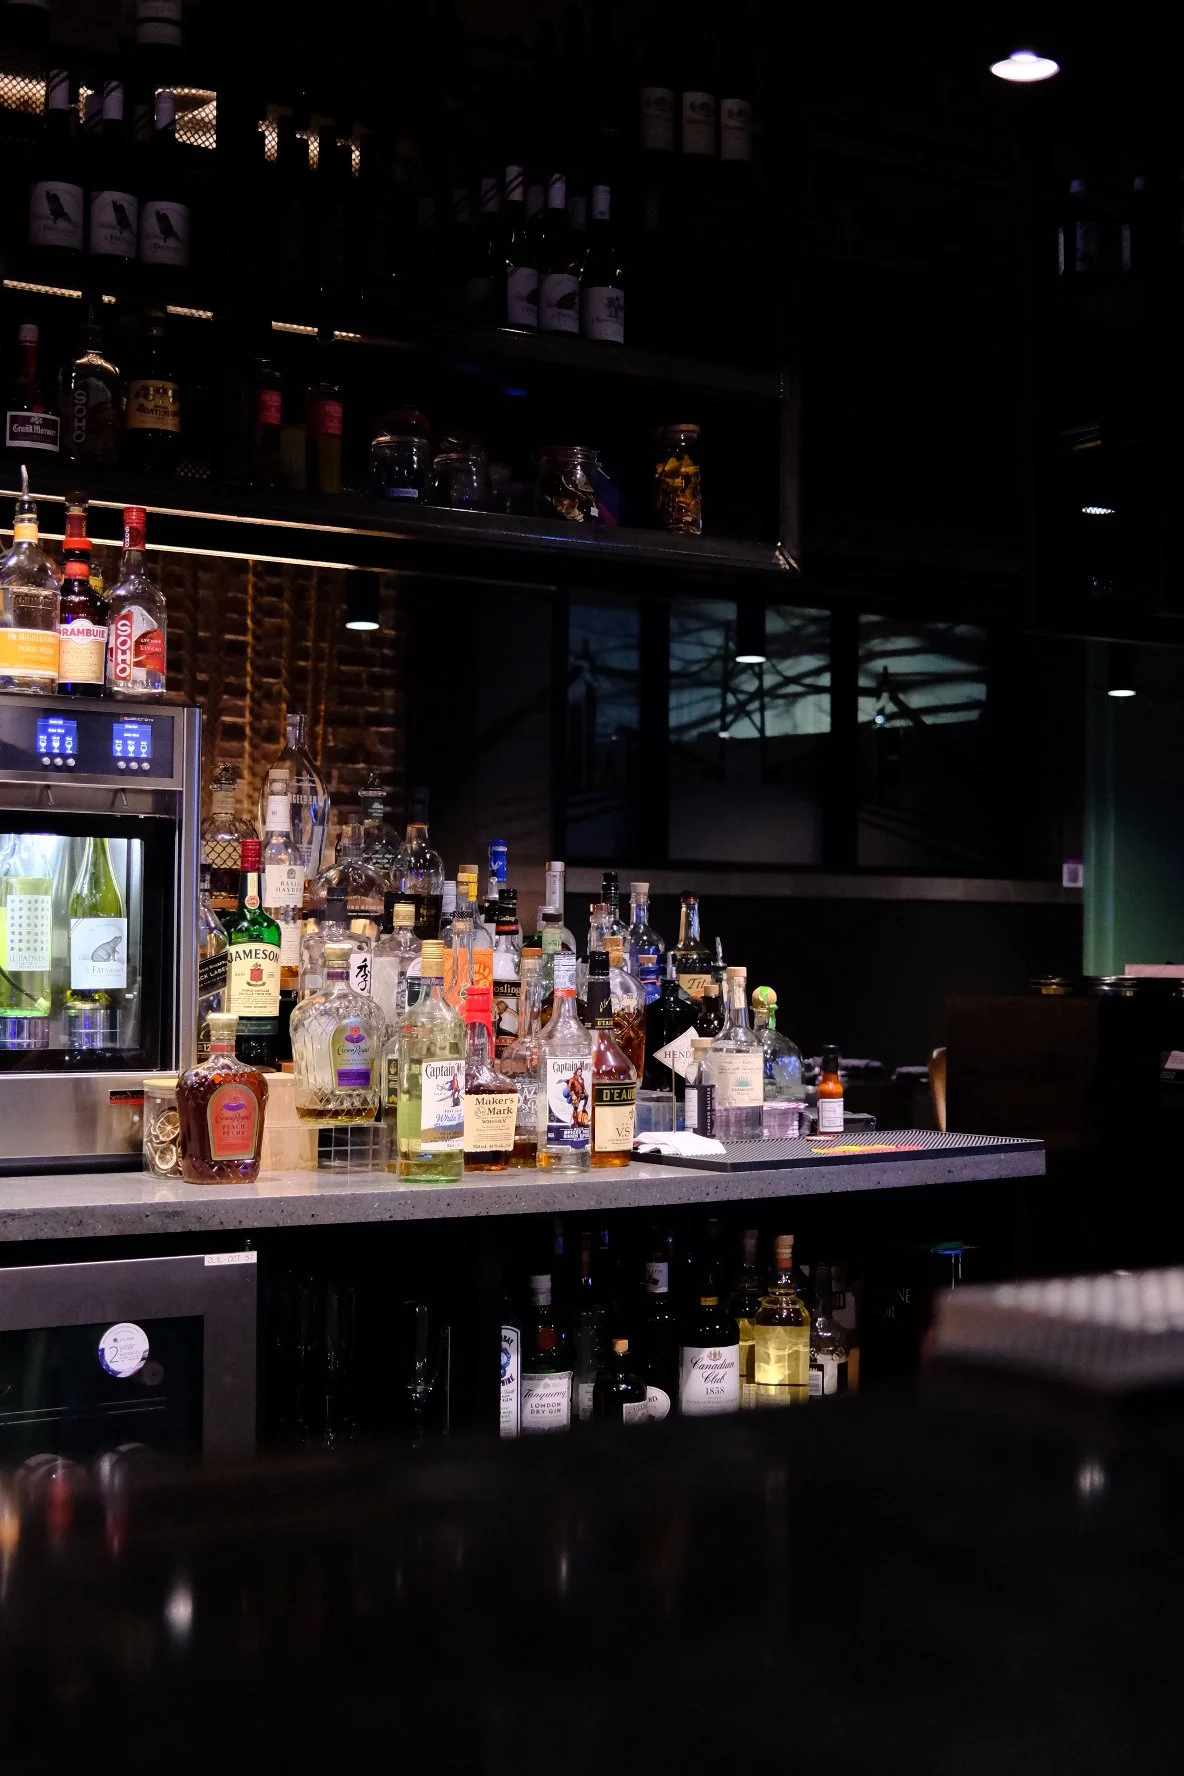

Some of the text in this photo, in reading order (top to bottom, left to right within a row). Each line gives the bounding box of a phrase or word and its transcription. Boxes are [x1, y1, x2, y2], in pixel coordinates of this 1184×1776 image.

[73, 390, 87, 443] SOHO
[116, 619, 132, 678] SOHO
[228, 948, 280, 964] JAMESON
[203, 1043, 212, 1052] 12
[425, 1063, 457, 1079] Captain
[552, 1061, 578, 1073] Captain
[475, 1097, 515, 1106] Maker's
[487, 1106, 513, 1115] Mark
[109, 1345, 119, 1363] 2
[690, 1355, 735, 1371] Canadian
[701, 1370, 726, 1384] Club
[523, 1388, 567, 1401] Tanqueray
[705, 1387, 725, 1396] 1858
